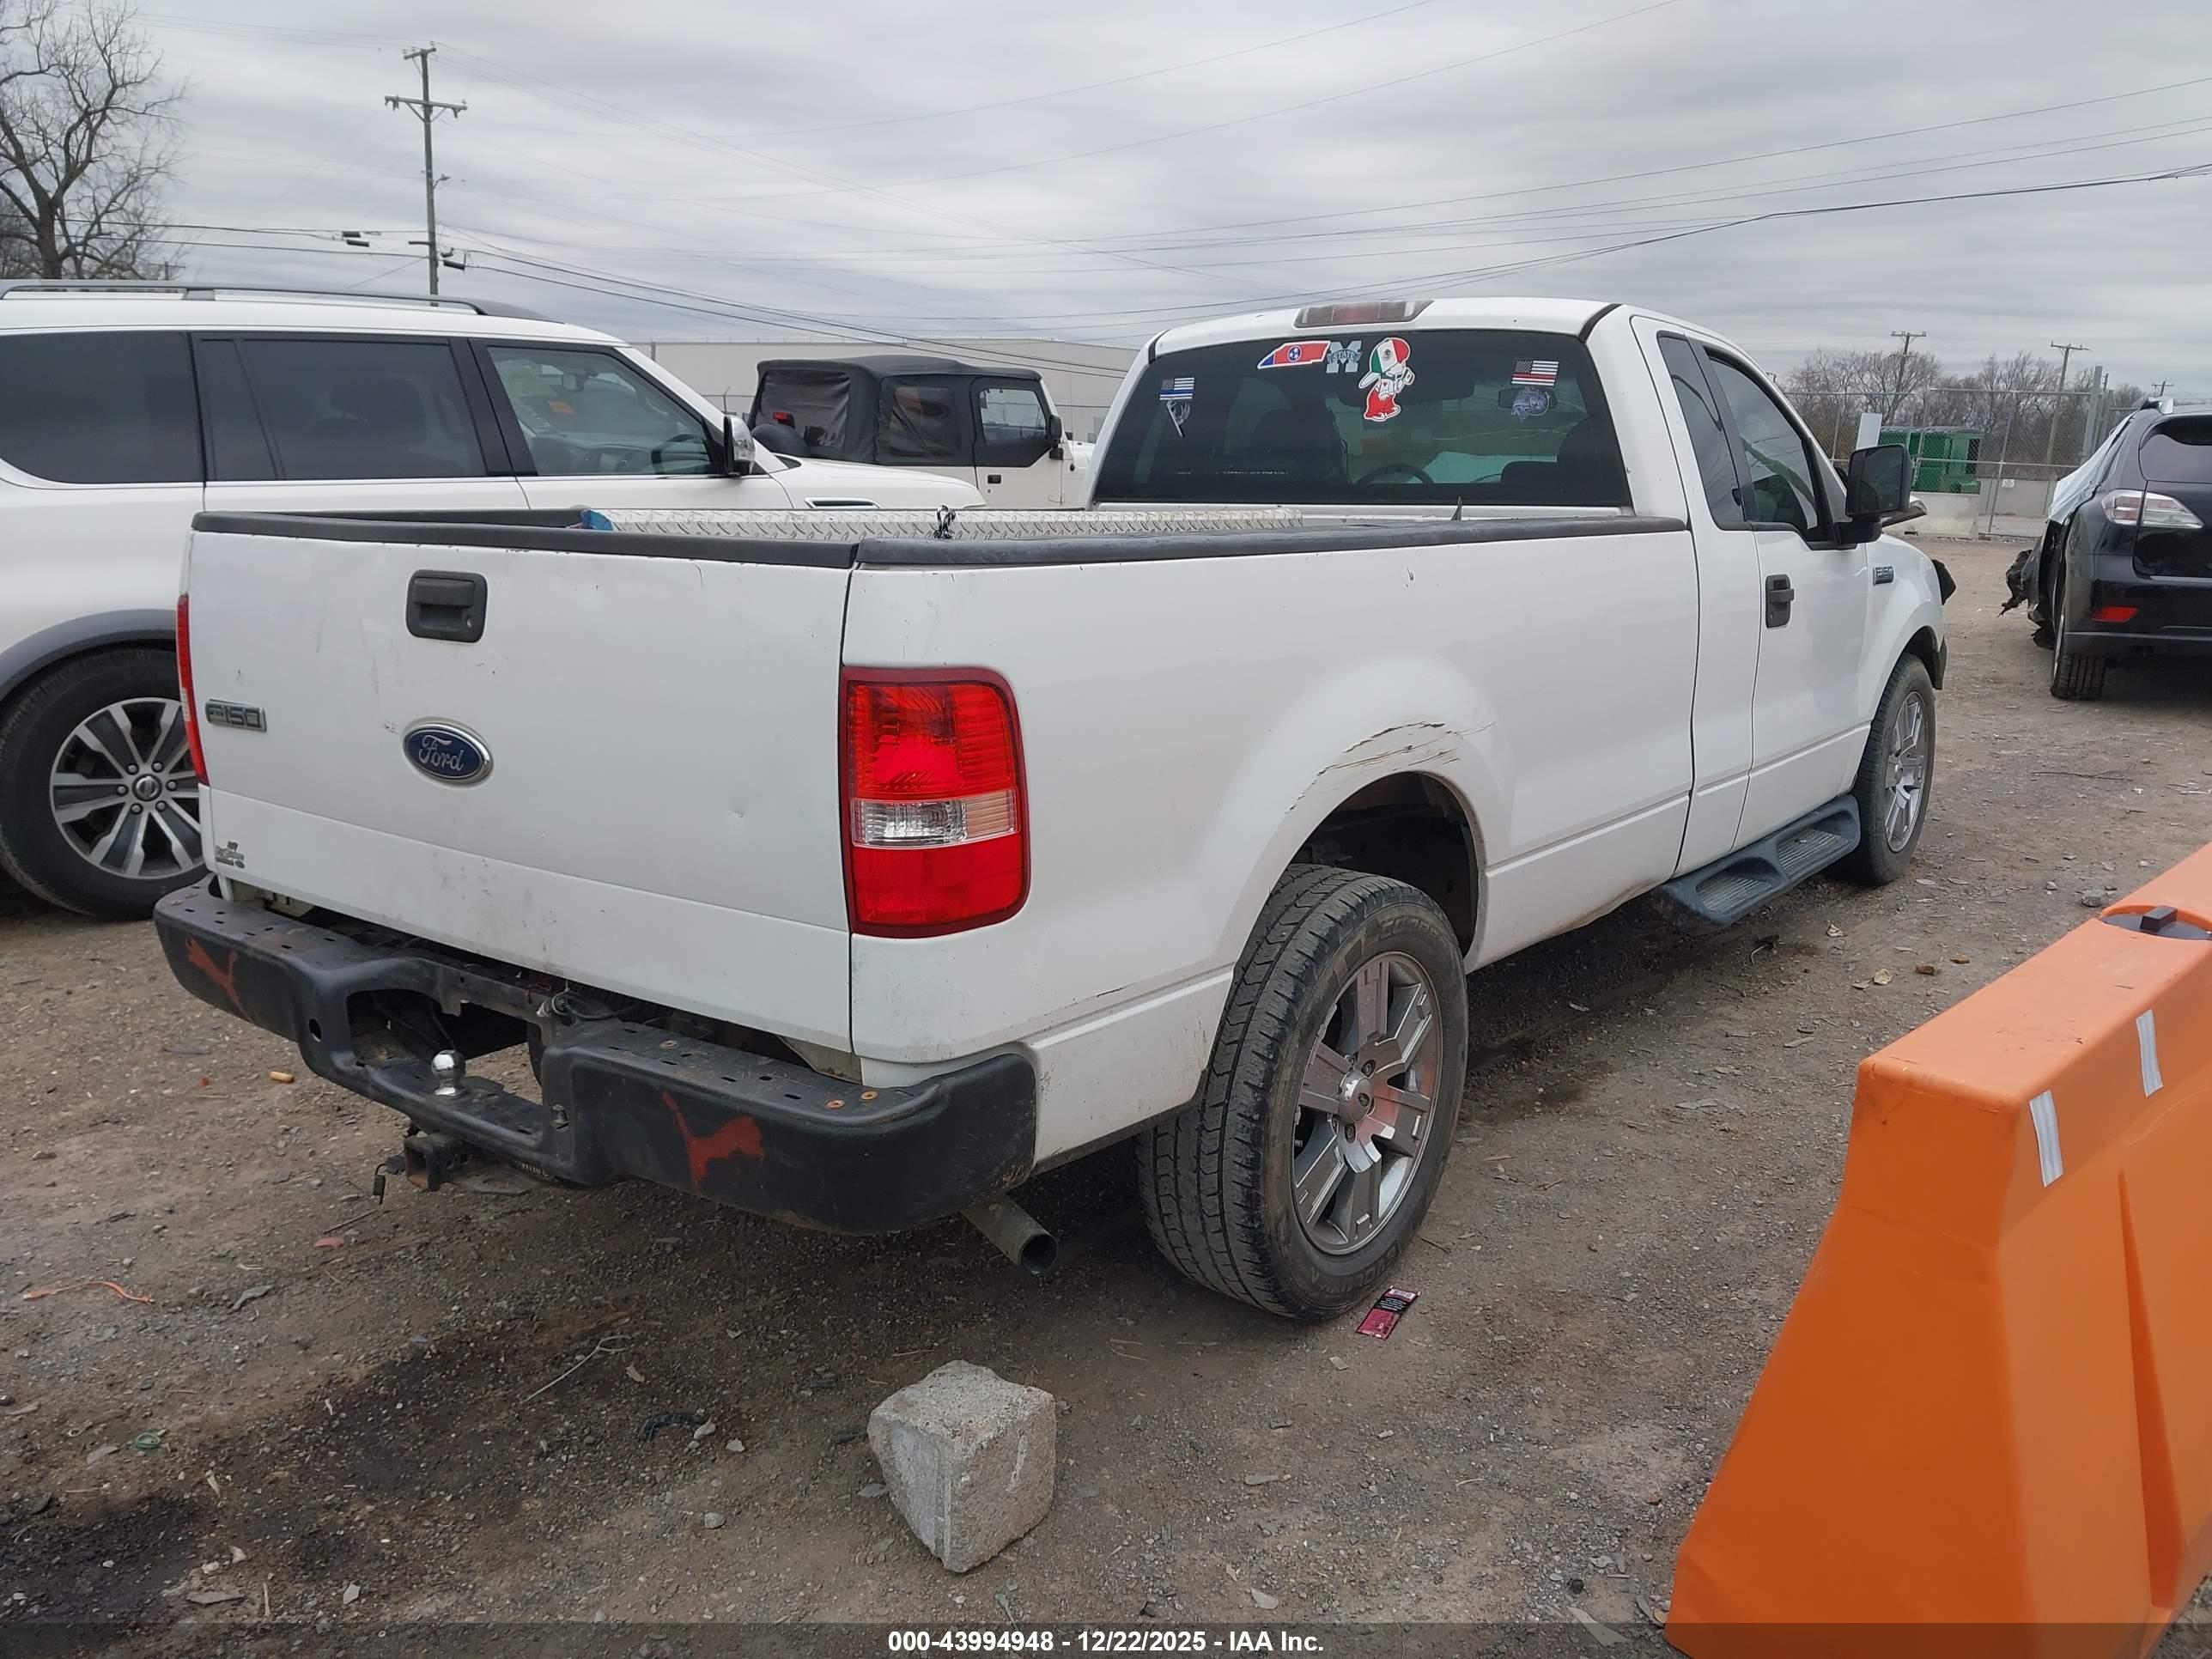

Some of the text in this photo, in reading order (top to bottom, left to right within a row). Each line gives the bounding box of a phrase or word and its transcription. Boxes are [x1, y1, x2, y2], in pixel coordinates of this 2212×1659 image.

[1326, 340, 1362, 374] M
[1332, 349, 1356, 362] STATE
[418, 734, 465, 771] Ford
